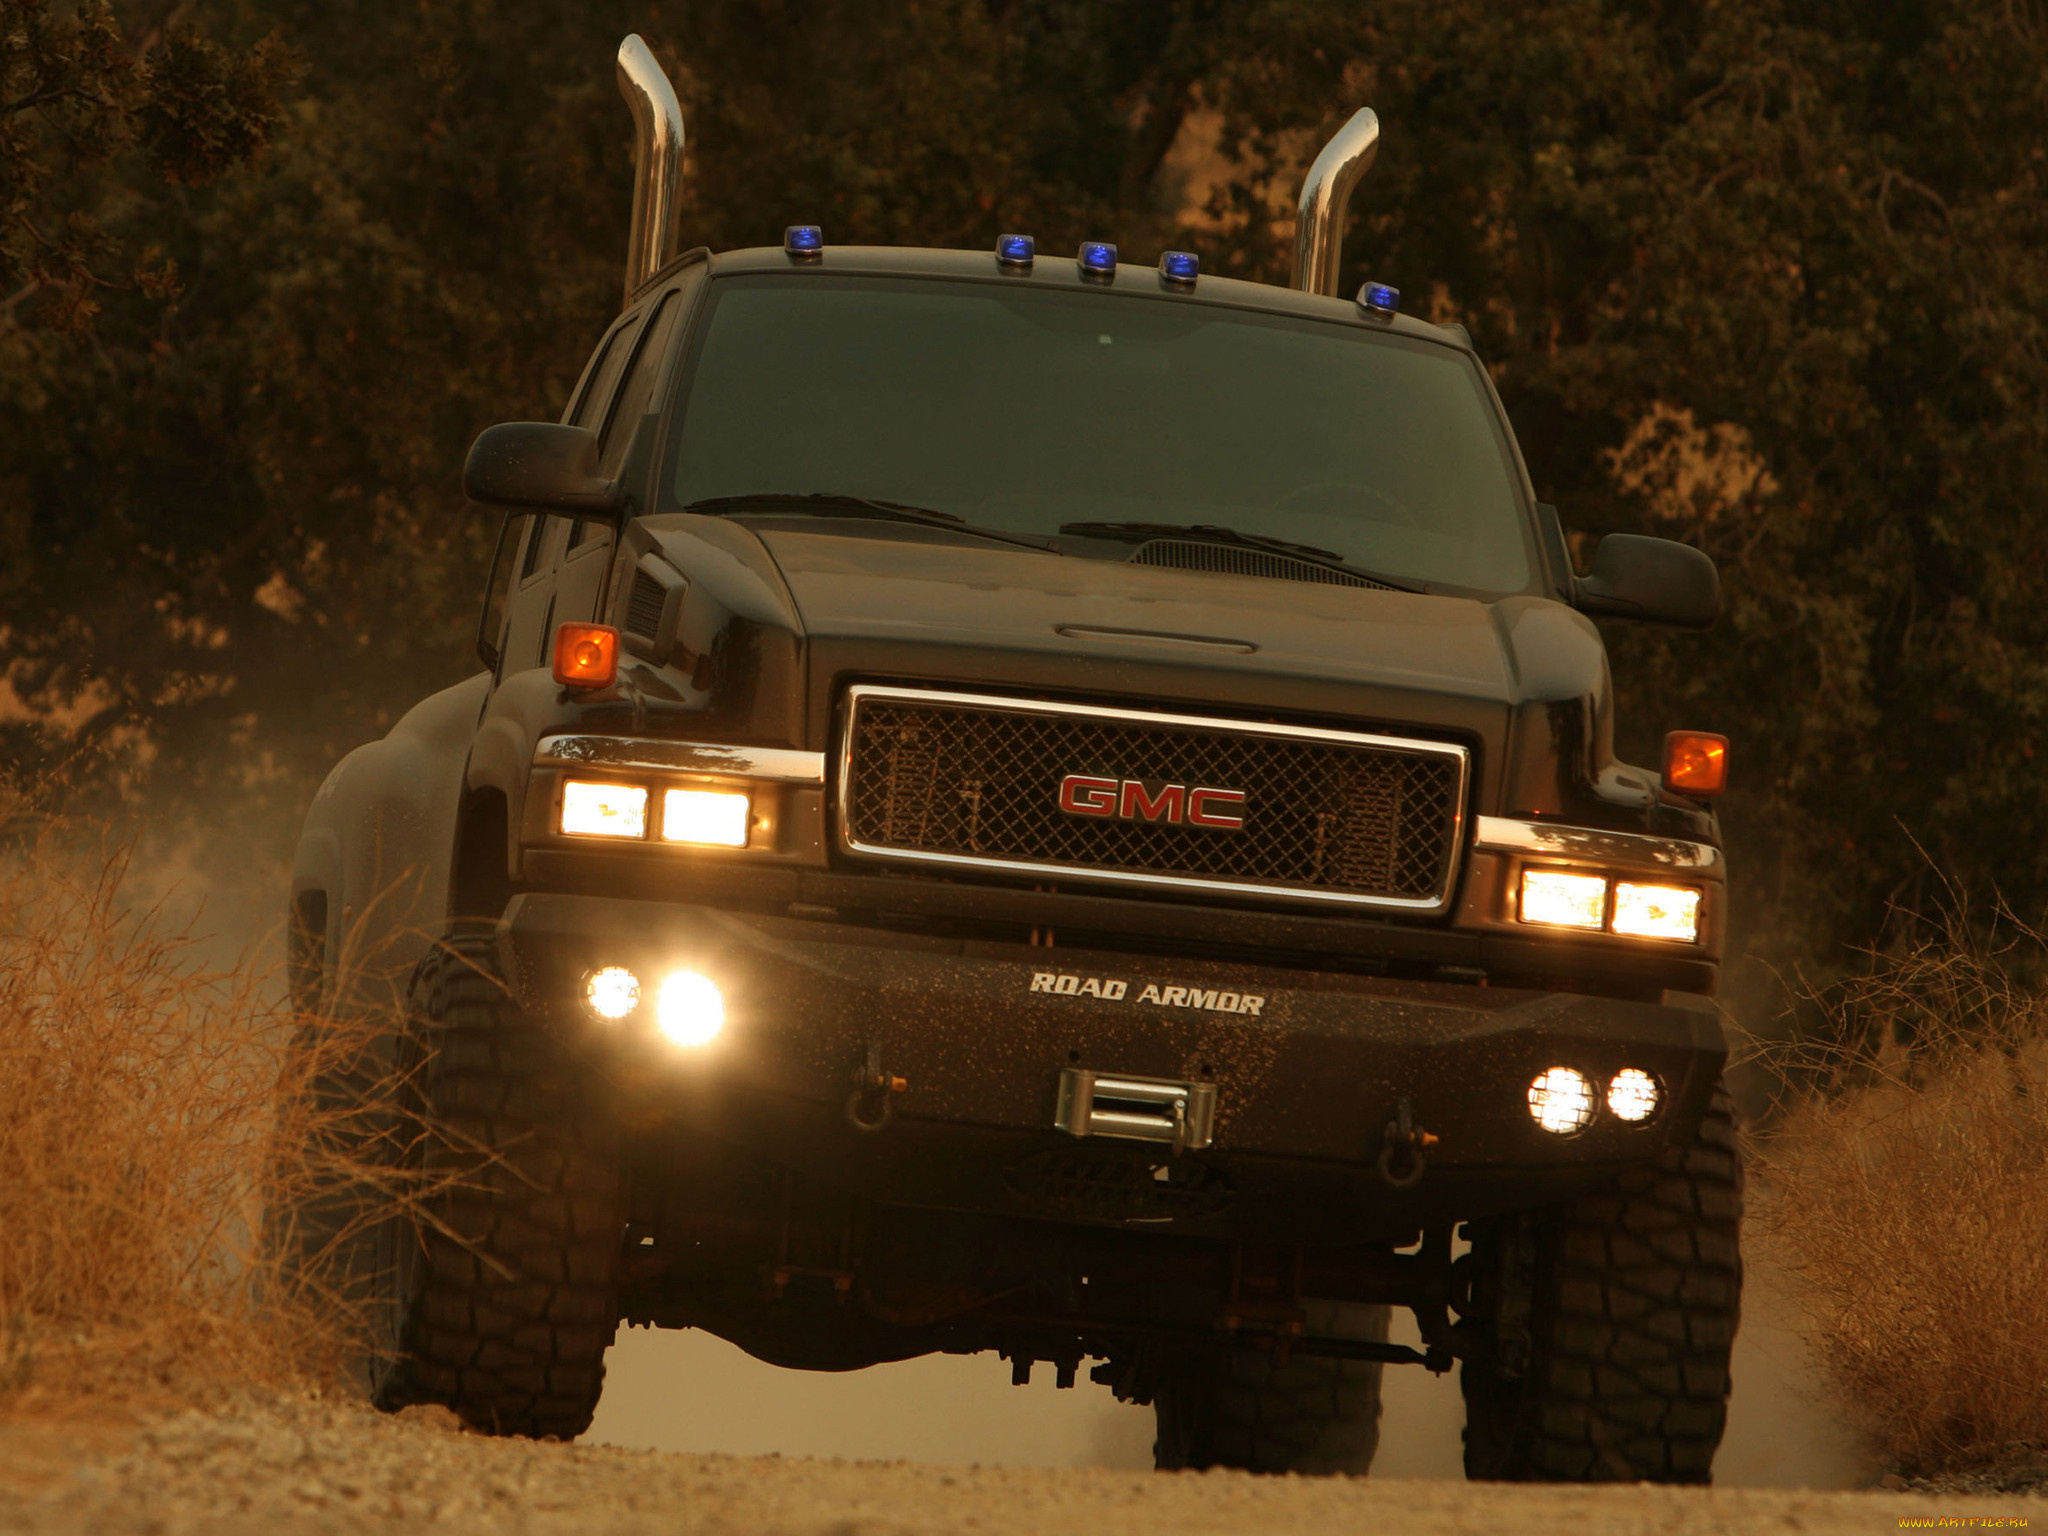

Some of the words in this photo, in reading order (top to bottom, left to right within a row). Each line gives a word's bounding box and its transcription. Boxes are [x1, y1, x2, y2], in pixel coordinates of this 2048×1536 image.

[1059, 775, 1245, 829] GMC
[1030, 973, 1127, 1000] ROAD
[1137, 985, 1265, 1016] ARMOR
